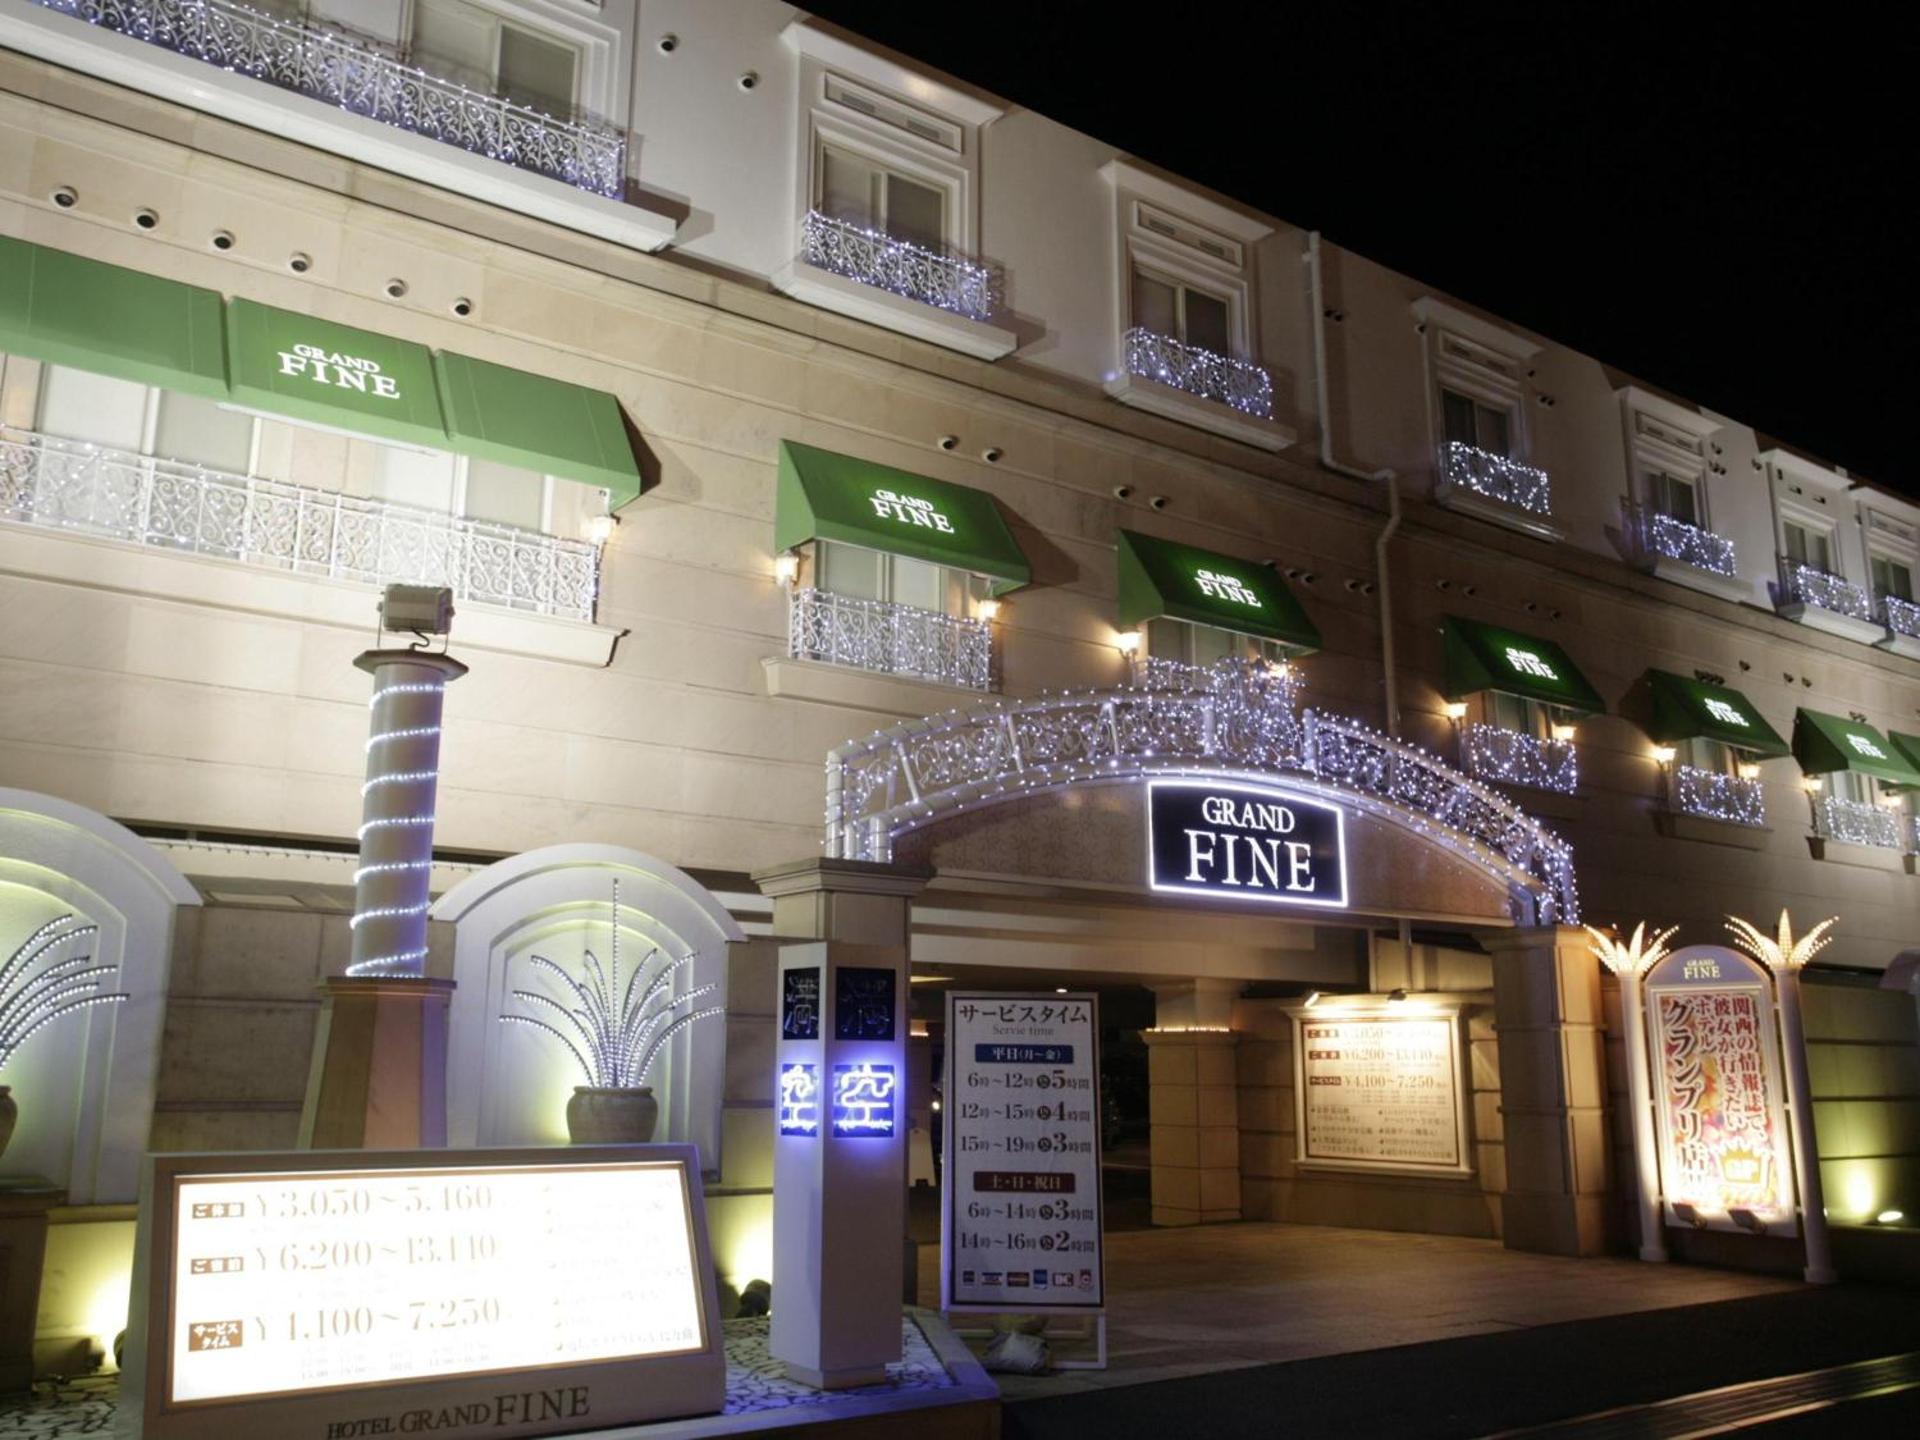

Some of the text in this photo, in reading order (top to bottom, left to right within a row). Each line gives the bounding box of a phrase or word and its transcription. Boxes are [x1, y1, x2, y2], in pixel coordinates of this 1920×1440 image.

[277, 351, 400, 399] FINE
[293, 344, 380, 373] GRAND
[869, 497, 955, 534] FINE
[876, 489, 934, 512] GRAND
[1194, 577, 1262, 608] FINE
[1202, 796, 1295, 833] GRAND
[1184, 829, 1315, 892] FINE
[1683, 966, 1720, 979] FINE
[959, 1004, 1088, 1024] サービスタイム
[841, 1063, 894, 1131] 空
[193, 1322, 238, 1338] サービス
[327, 1386, 590, 1440] HOTEL GRAND FINE
